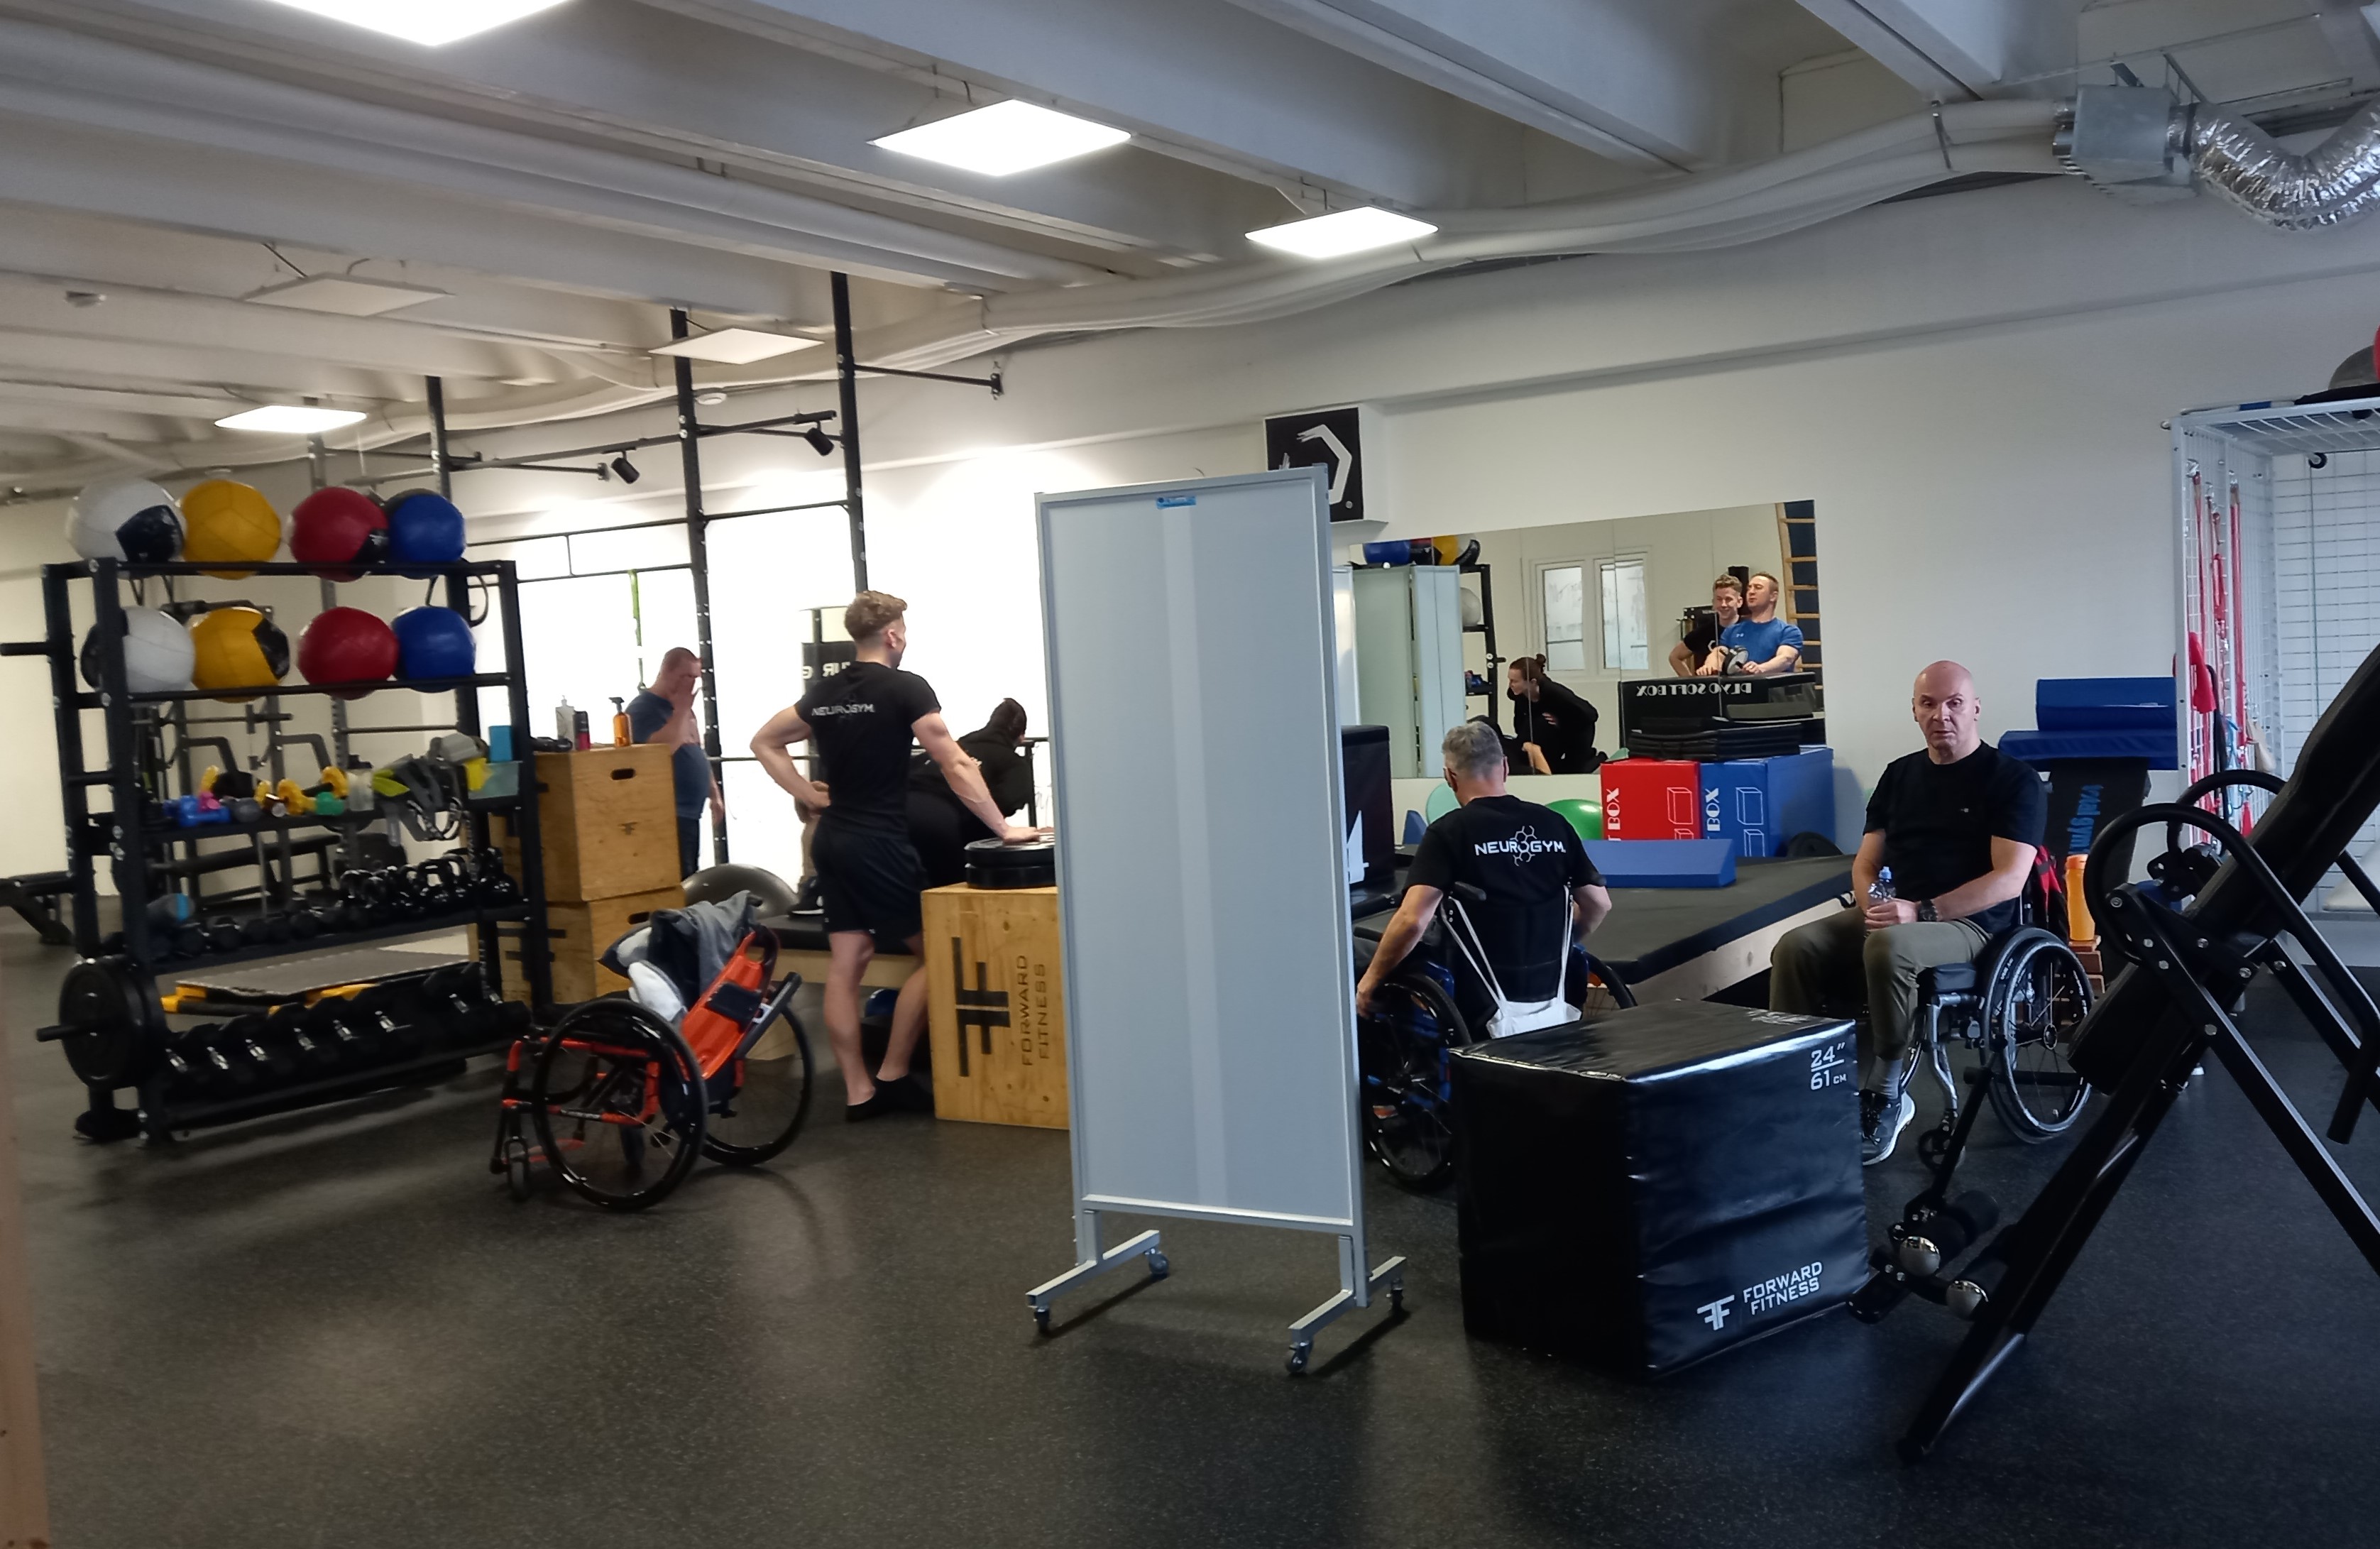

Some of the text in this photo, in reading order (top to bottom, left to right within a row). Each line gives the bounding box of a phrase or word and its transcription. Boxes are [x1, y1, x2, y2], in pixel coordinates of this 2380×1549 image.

[1606, 787, 1621, 831] BOX
[1705, 787, 1721, 831] BOX
[1016, 955, 1033, 1066] FORWARD
[1033, 963, 1050, 1060] FITNESS
[1743, 1261, 1823, 1303] FORWARD
[1750, 1277, 1820, 1315] FITNESS
